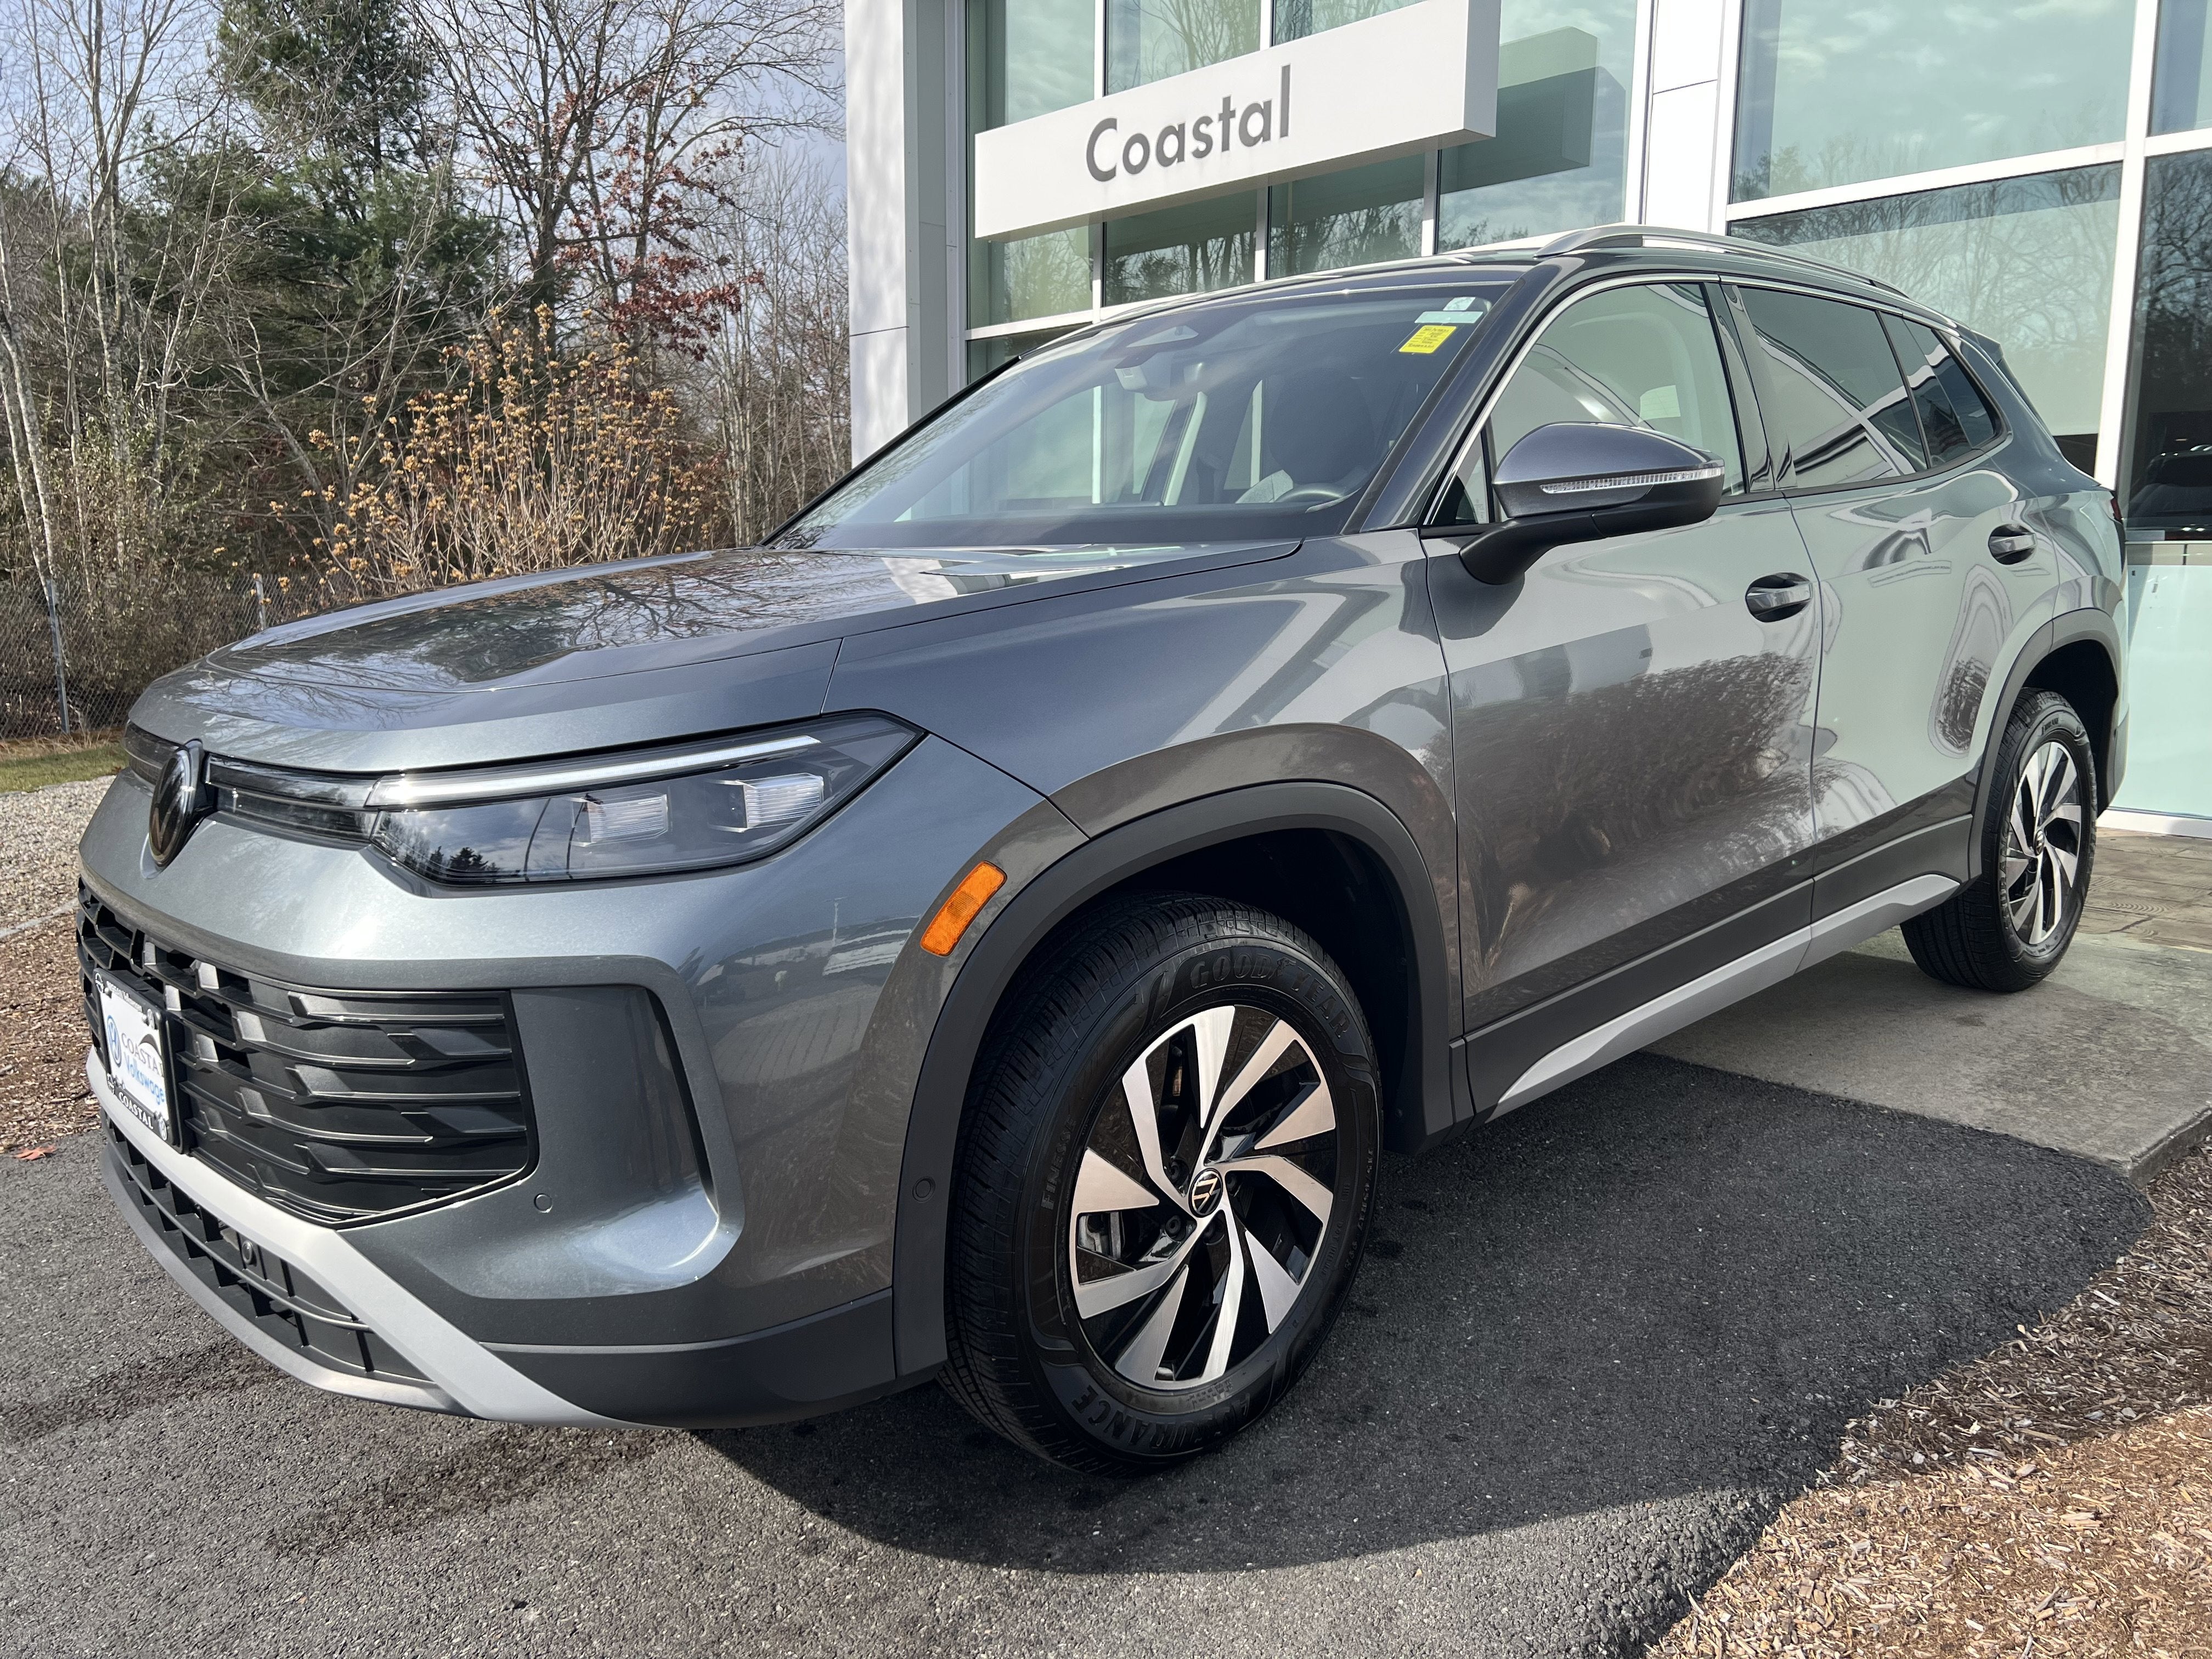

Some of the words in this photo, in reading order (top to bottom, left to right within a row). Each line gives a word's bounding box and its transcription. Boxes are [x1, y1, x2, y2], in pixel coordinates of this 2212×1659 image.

[1086, 63, 1291, 182] Coastal
[119, 1091, 154, 1130] COASTAL
[123, 1051, 165, 1105] Volkswage
[1040, 1114, 1077, 1210] FINESSE
